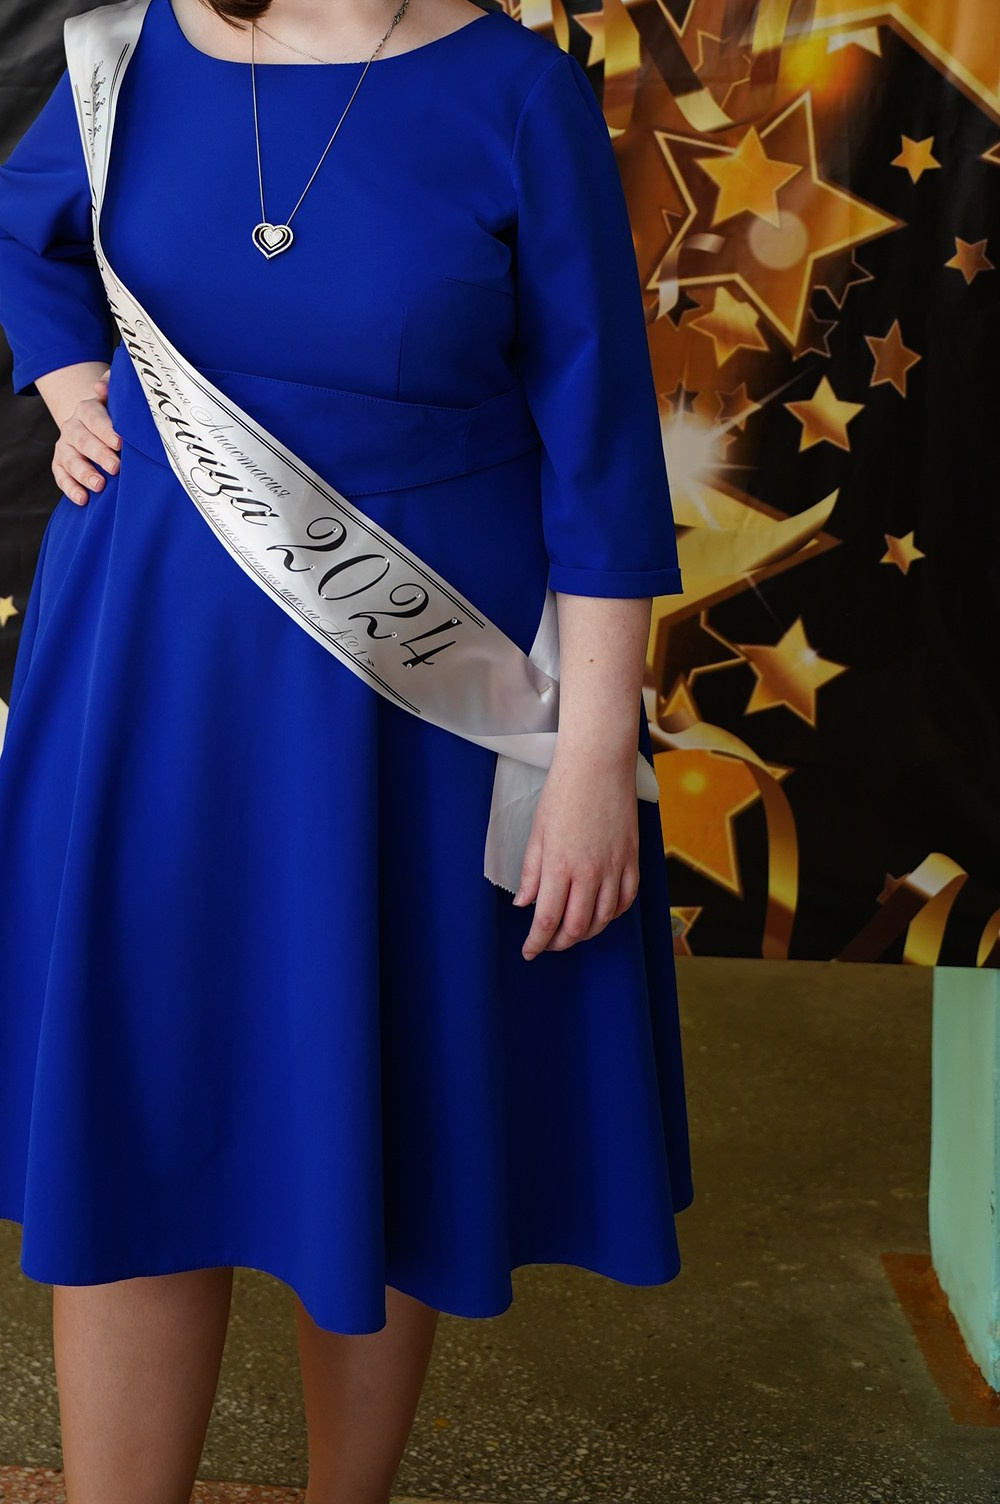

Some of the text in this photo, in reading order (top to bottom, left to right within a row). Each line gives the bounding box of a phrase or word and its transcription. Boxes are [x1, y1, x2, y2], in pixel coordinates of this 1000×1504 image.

[190, 404, 292, 499] Анастасия
[266, 516, 463, 670] 2024
[280, 588, 320, 620] школа
